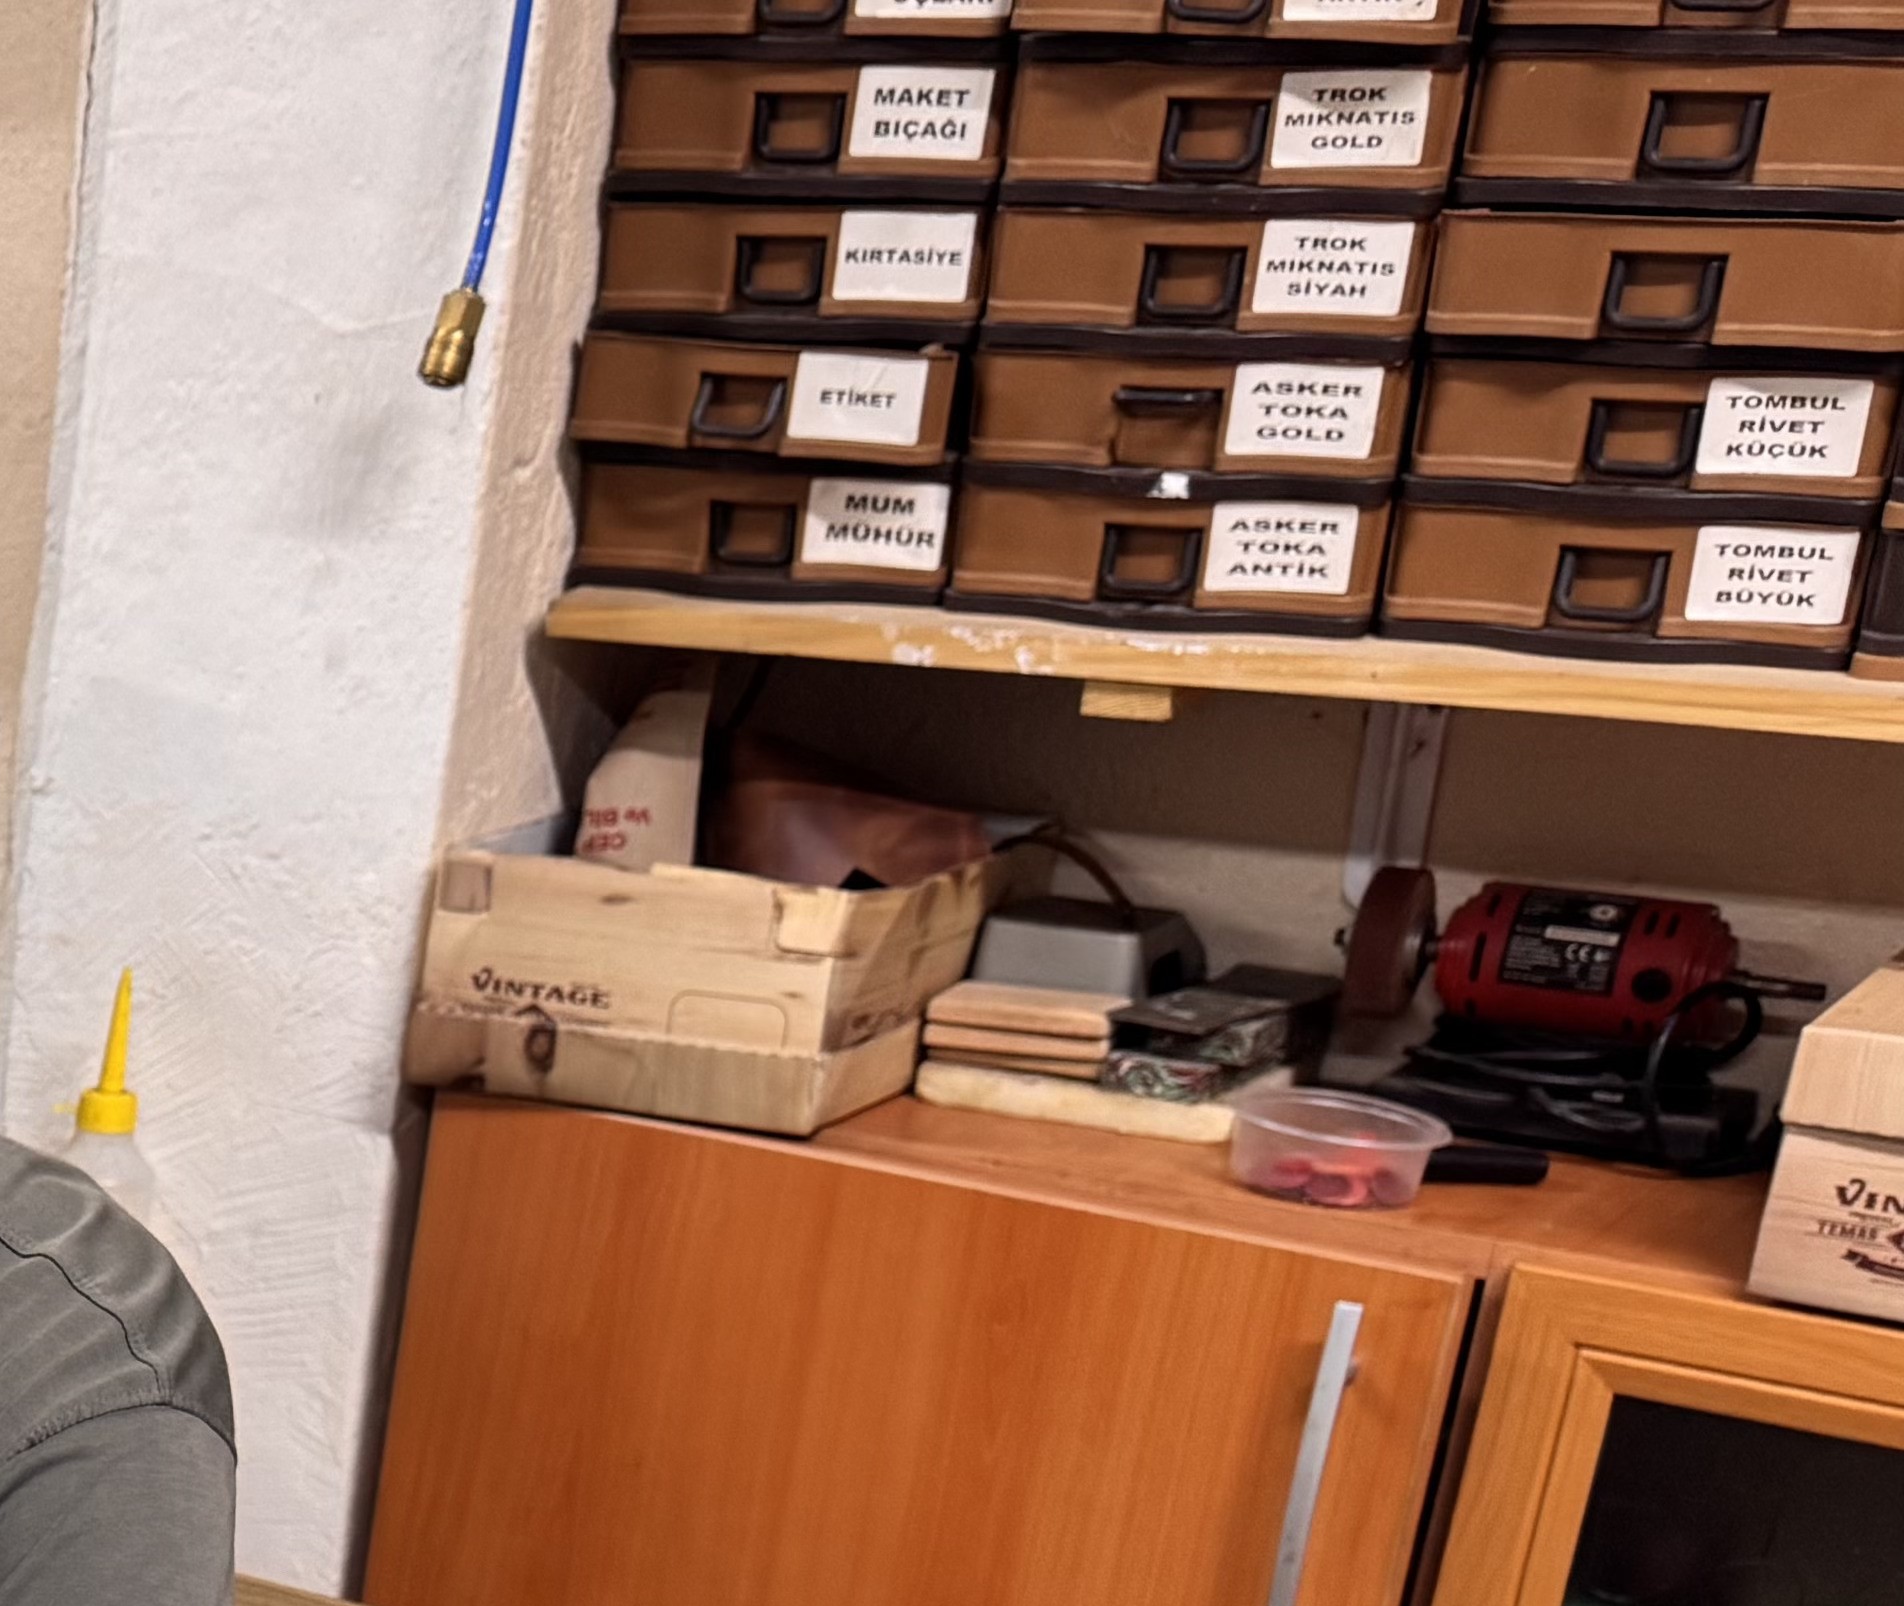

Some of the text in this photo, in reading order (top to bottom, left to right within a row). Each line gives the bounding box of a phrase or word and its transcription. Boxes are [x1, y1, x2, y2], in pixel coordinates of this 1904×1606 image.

[873, 87, 971, 109] MAKET
[1312, 86, 1389, 103] TROK
[1283, 110, 1416, 127] MIKNATIS
[872, 119, 967, 142] BIÇAĞI
[1310, 134, 1384, 151] GOLD
[1295, 236, 1368, 252] TROK
[844, 246, 964, 267] KIRTASİYE
[1265, 259, 1396, 277] MIKNATIS
[1286, 280, 1367, 298] SİYAH
[1250, 379, 1364, 397] ASKER
[819, 387, 897, 409] ETİKET
[1725, 395, 1847, 412] TOMBUL
[1258, 402, 1349, 421] TOKA
[1255, 424, 1345, 443] GOLD
[1738, 415, 1826, 434] RİVET
[1725, 440, 1829, 460] KÜÇÜK
[844, 493, 916, 515] MUM
[824, 521, 935, 549] MÜHÜR
[1228, 517, 1340, 535] ASKER
[1236, 538, 1327, 556] TOKA
[1714, 543, 1835, 561] TOMBUL
[1227, 562, 1330, 579] ANTİK
[1726, 564, 1814, 584] RİVET
[1714, 588, 1817, 608] BÜYÜK
